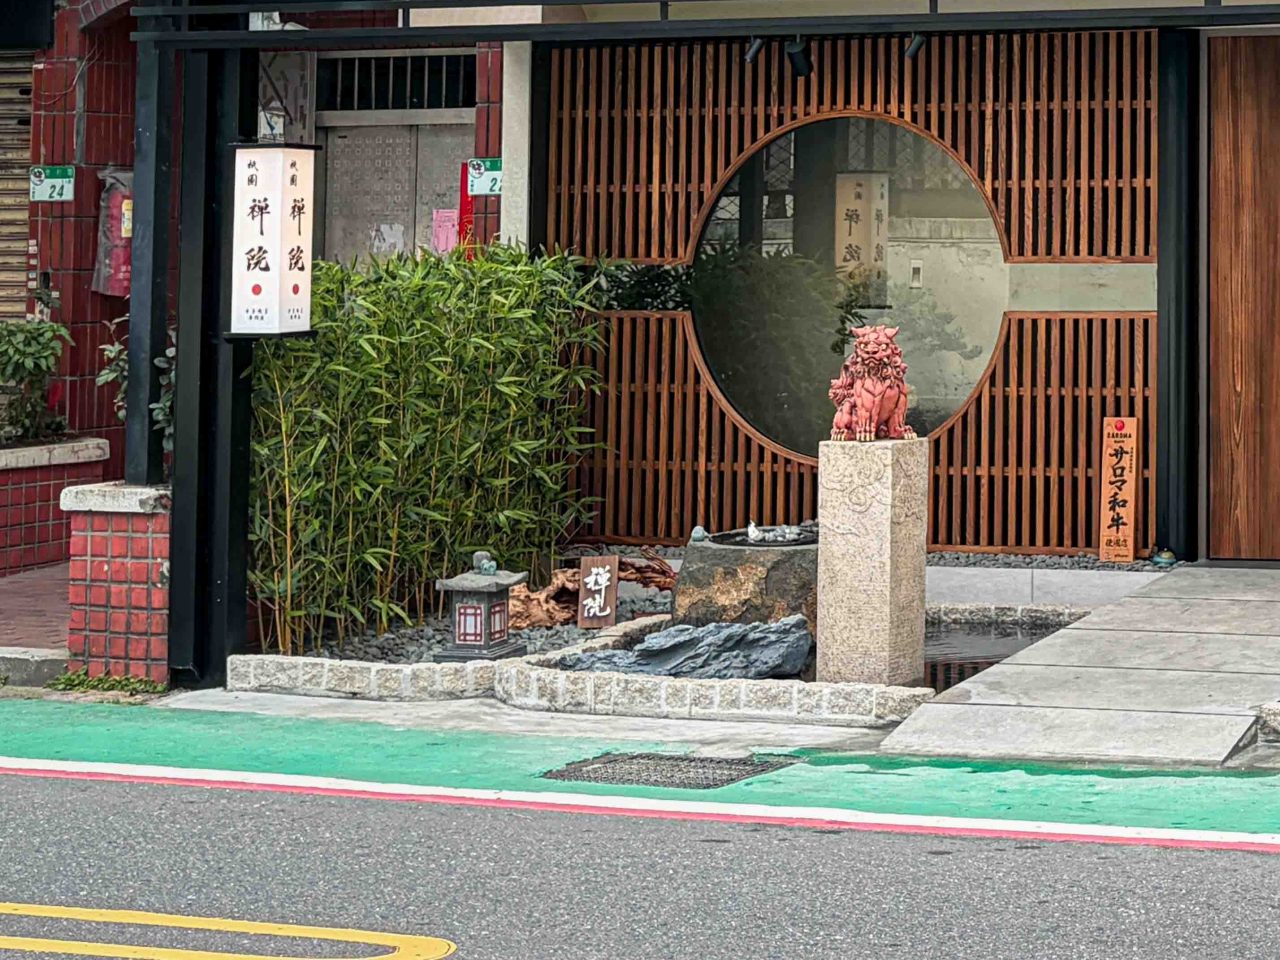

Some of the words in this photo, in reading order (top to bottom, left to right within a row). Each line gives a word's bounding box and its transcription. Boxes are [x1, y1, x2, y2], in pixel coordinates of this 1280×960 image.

[48, 184, 65, 199] 24
[1107, 445, 1129, 534] サロマ和牛
